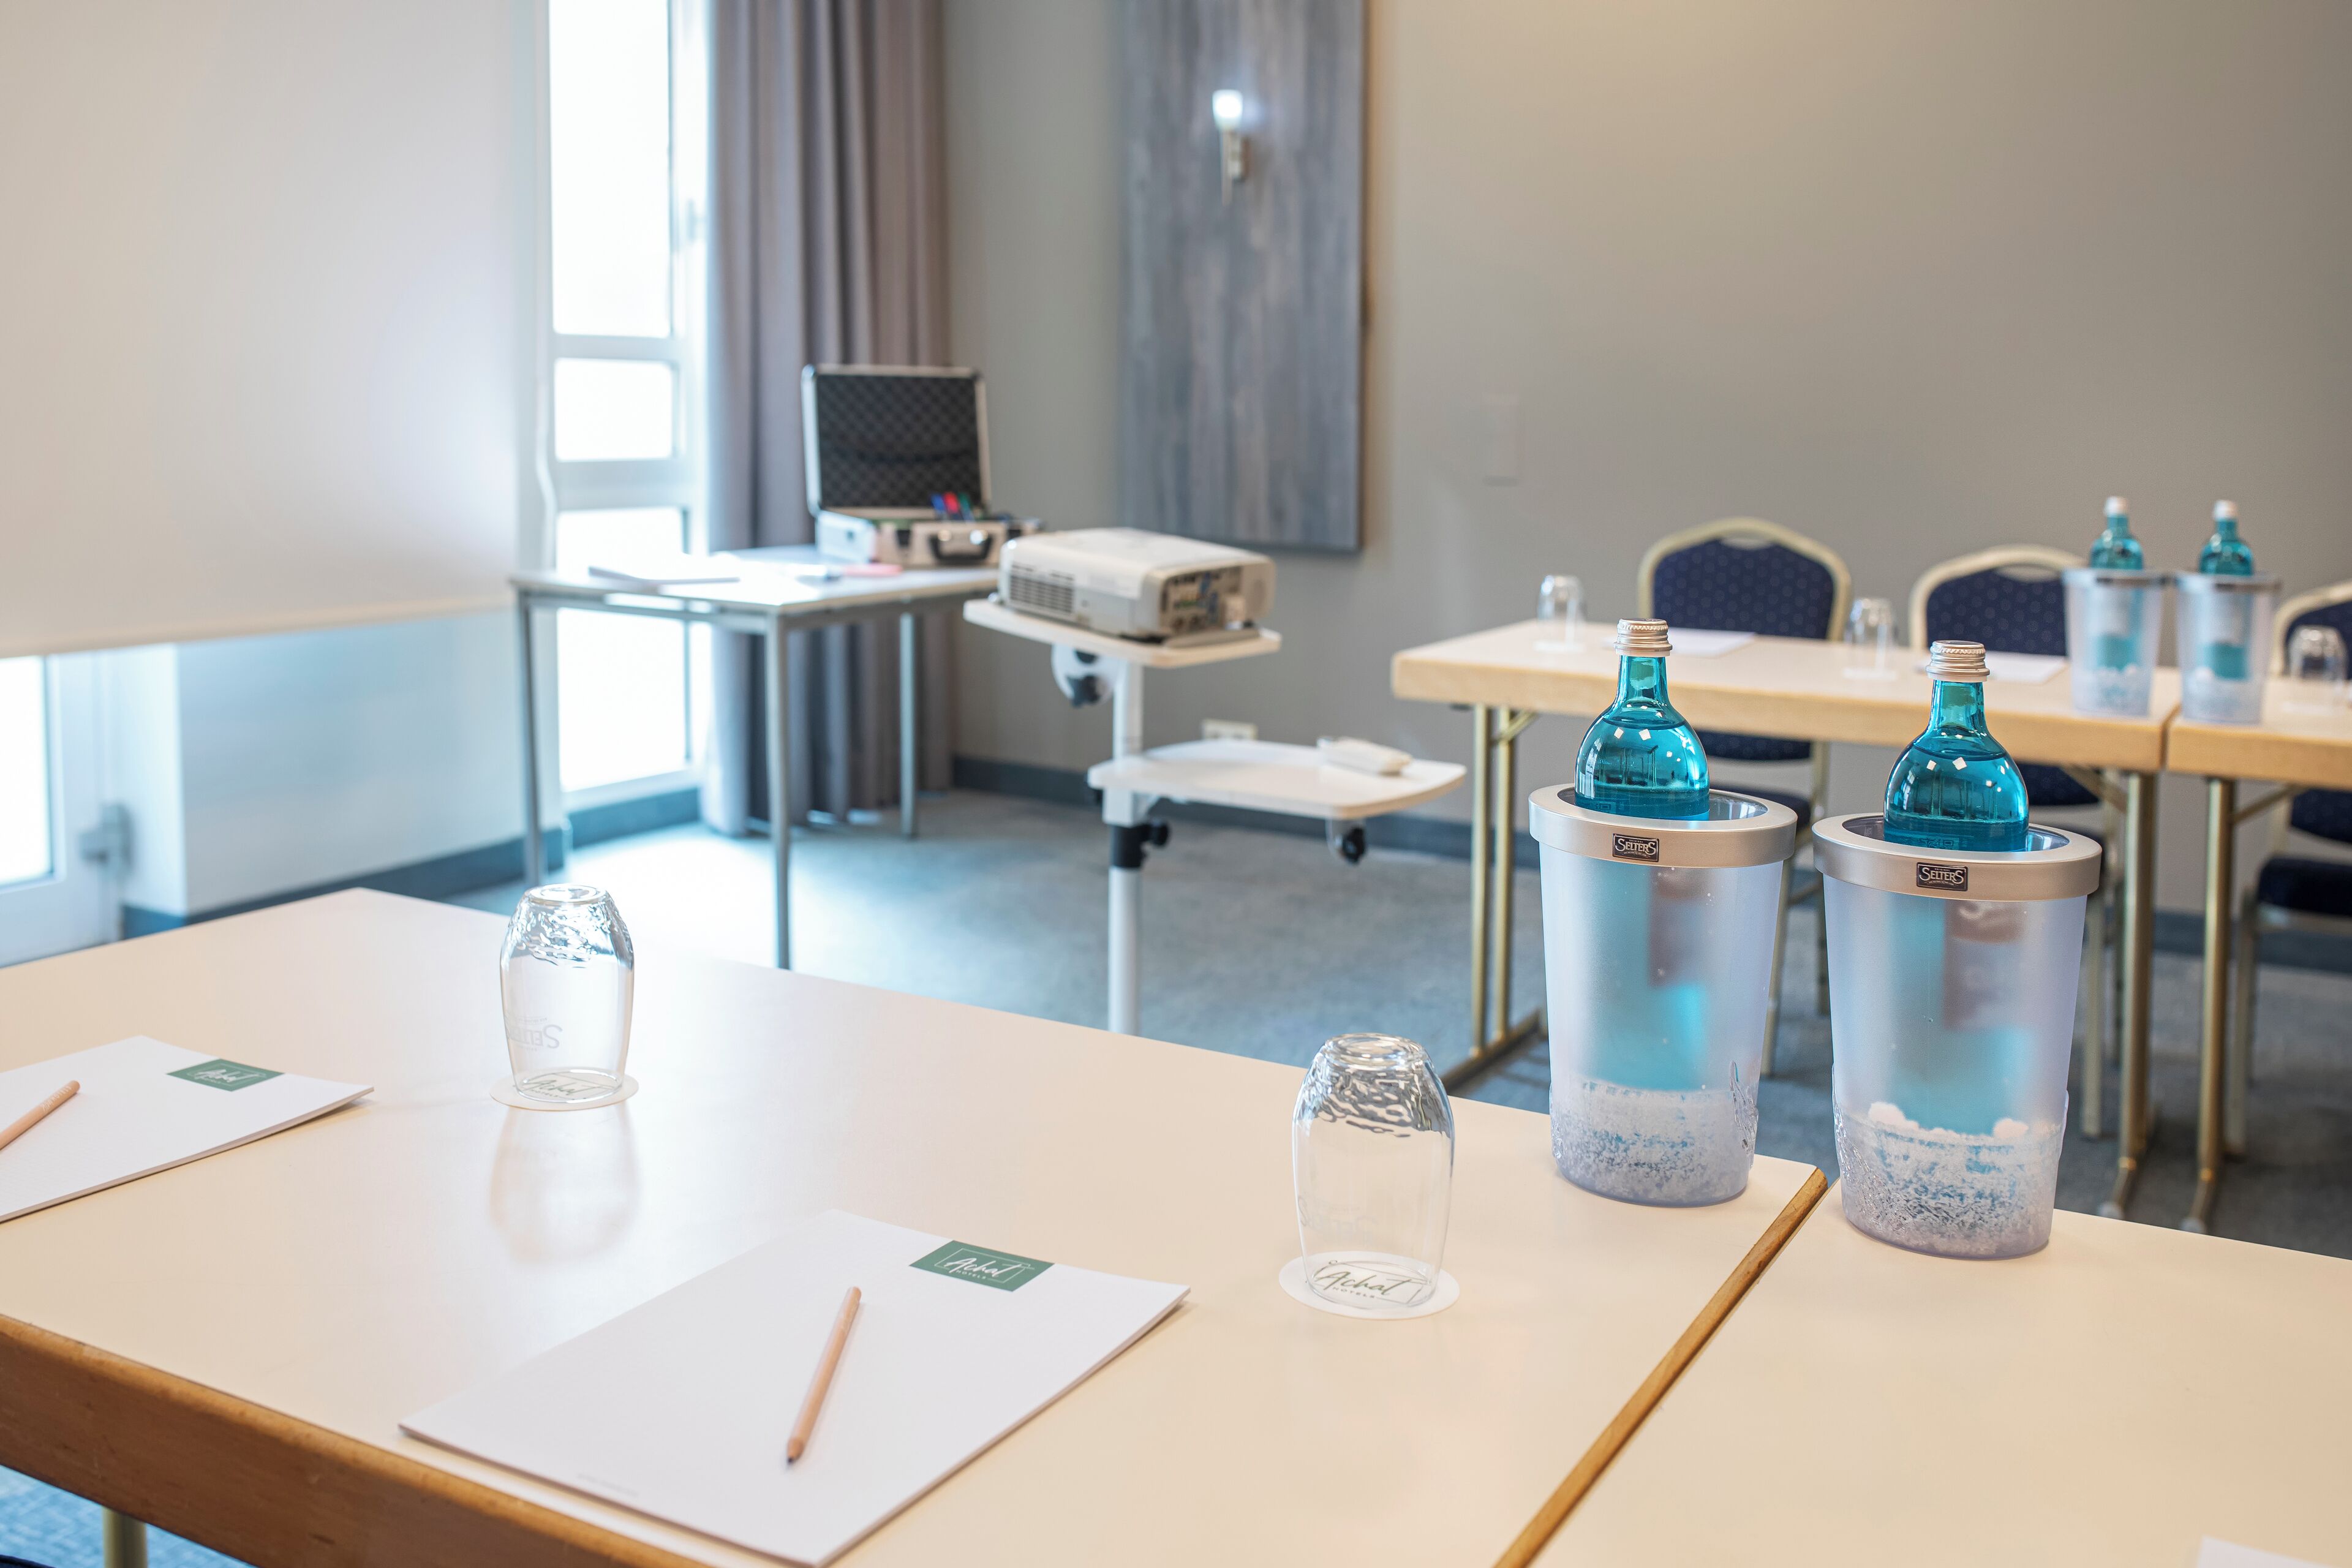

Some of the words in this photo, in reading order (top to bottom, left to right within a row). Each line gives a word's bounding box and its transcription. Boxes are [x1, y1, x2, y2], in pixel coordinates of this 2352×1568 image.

[1615, 838, 1656, 855] SELTERS
[1919, 867, 1964, 884] SELTERS
[944, 1257, 1034, 1278] Achat
[956, 1270, 987, 1280] HOTELS
[1314, 1271, 1426, 1295] Achat
[1332, 1286, 1376, 1298] HOTELS
